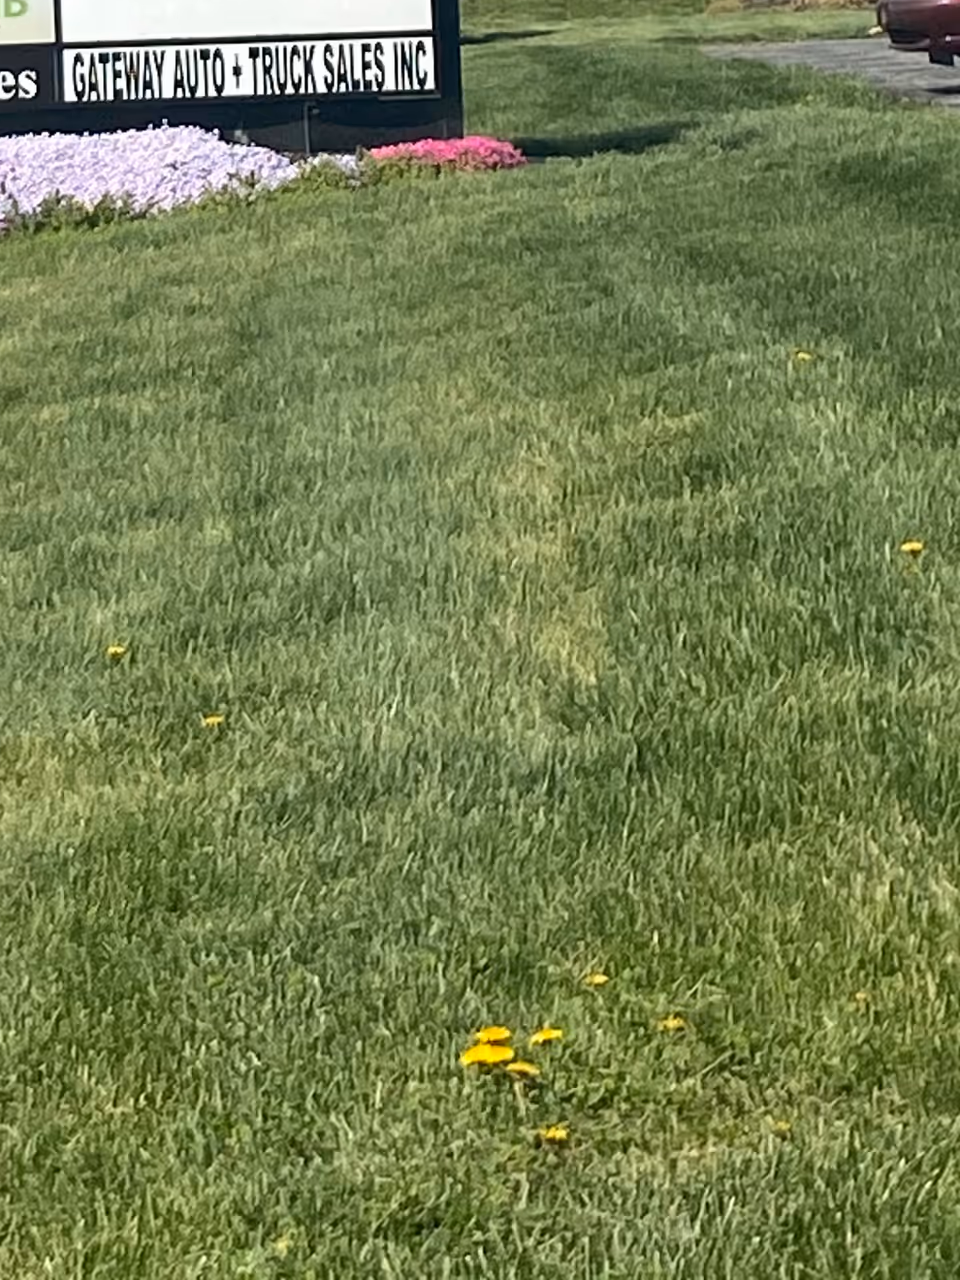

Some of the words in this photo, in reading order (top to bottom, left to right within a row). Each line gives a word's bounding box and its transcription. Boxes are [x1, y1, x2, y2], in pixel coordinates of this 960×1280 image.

[73, 49, 167, 102] GATEWAY
[173, 47, 226, 100] AUTO
[249, 44, 318, 96] TRUCK
[323, 41, 385, 93] SALES
[393, 39, 428, 91] INC
